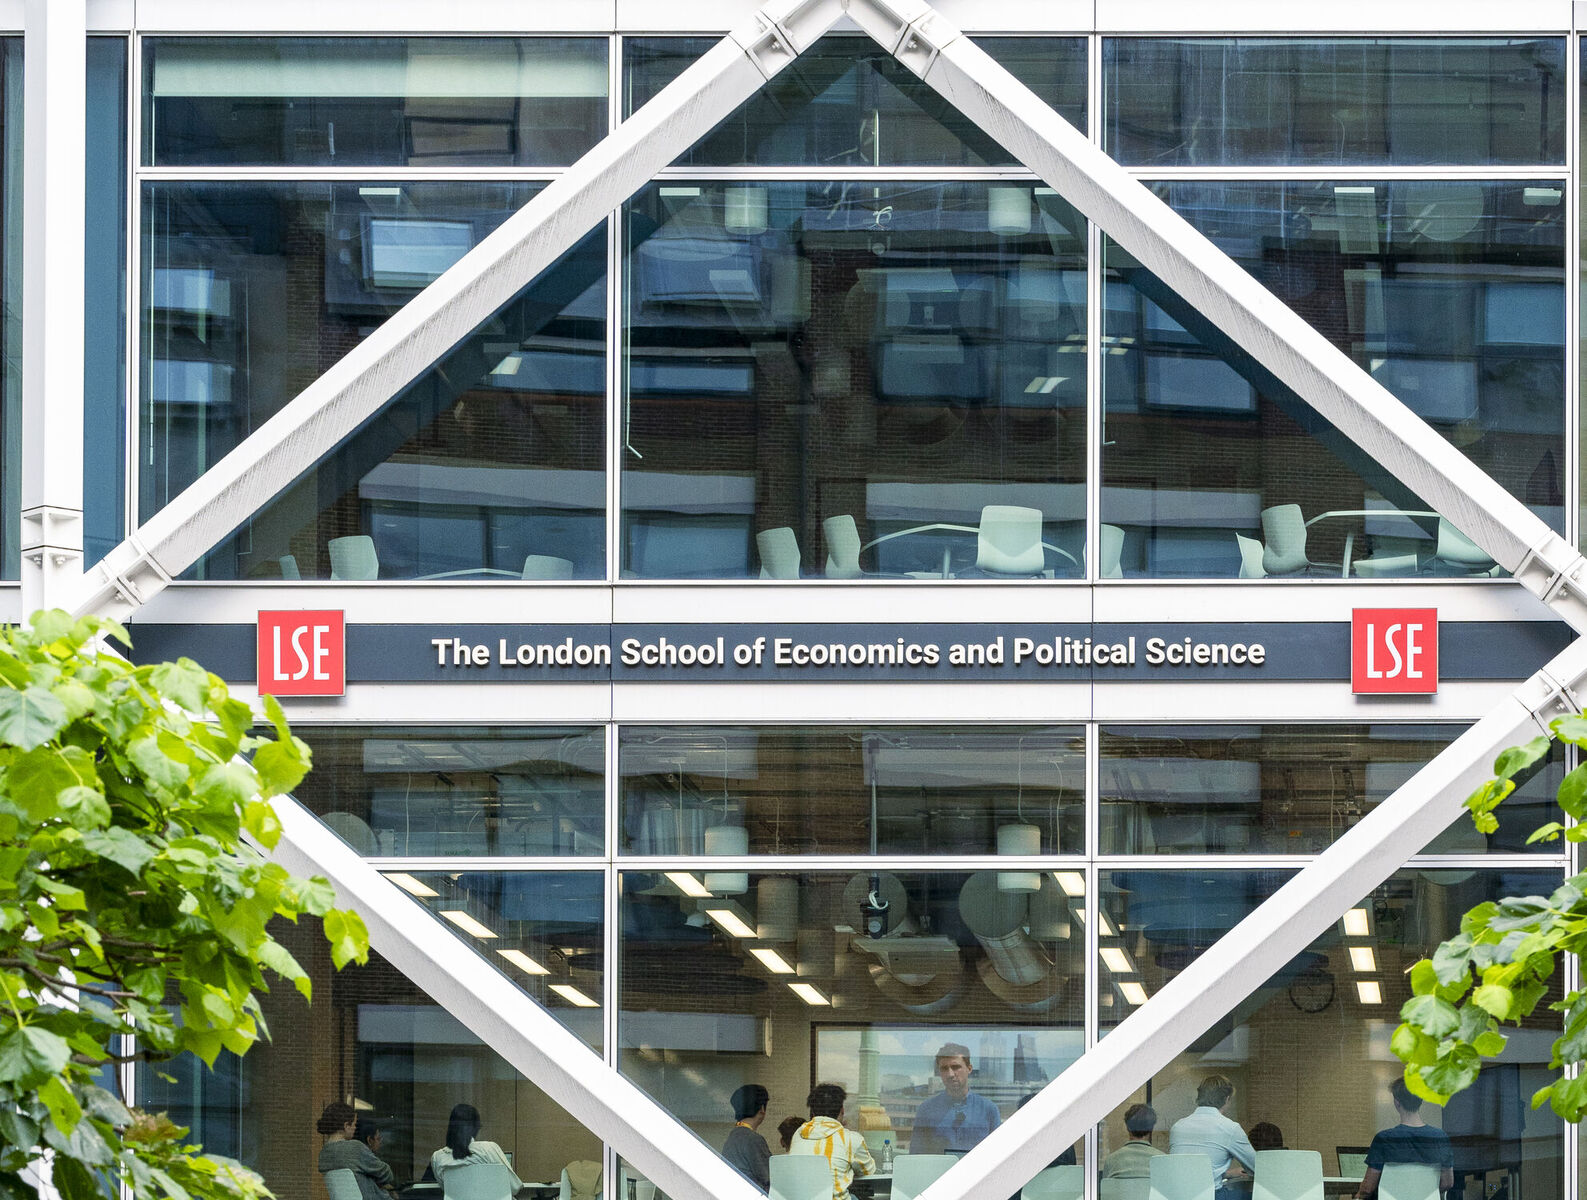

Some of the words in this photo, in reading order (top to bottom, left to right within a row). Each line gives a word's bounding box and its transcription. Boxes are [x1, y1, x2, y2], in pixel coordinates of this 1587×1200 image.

[274, 626, 330, 681] LSE
[431, 637, 490, 665] The
[500, 637, 611, 665] London
[621, 636, 724, 665] School
[734, 636, 766, 665] of
[775, 637, 940, 666] Economics
[949, 636, 1004, 665] and
[1015, 636, 1136, 665] Political
[1146, 636, 1266, 665] Science
[1367, 624, 1423, 679] LSE
